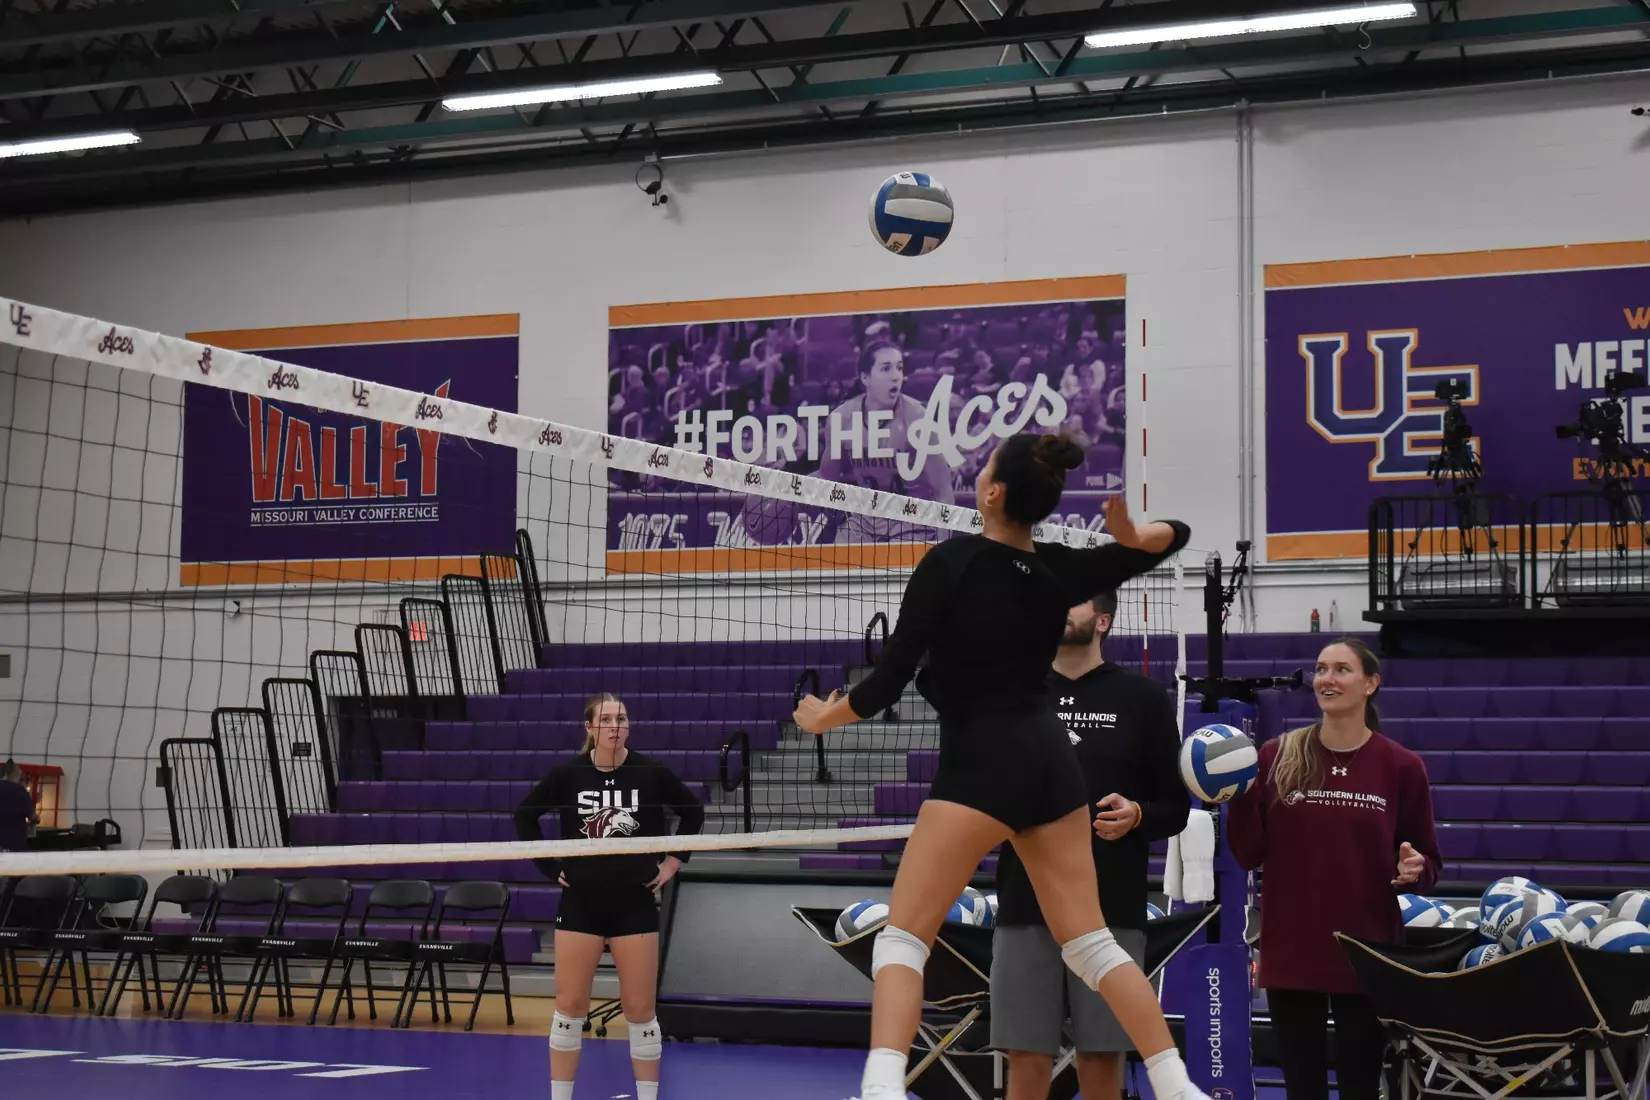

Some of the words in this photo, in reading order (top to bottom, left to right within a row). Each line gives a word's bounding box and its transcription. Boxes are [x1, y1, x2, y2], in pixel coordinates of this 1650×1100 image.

[98, 326, 134, 354] Aces
[267, 364, 300, 390] Aces
[415, 396, 444, 421] Aces
[538, 423, 563, 446] Aces
[249, 378, 451, 502] VALLEY
[250, 510, 309, 523] MISSOURI
[313, 508, 355, 522] VALLEY
[358, 506, 439, 521] CONFERENCE
[1074, 712, 1117, 722] ILLINOIS
[577, 789, 640, 815] SIU
[1307, 789, 1353, 800] SOUTHERN
[1354, 792, 1387, 807] ILLINOIS
[1318, 799, 1376, 810] VOLLEYBALL
[261, 938, 296, 946] EVANSVILLE
[1206, 967, 1222, 1016] sports
[1207, 1018, 1223, 1078] imports
